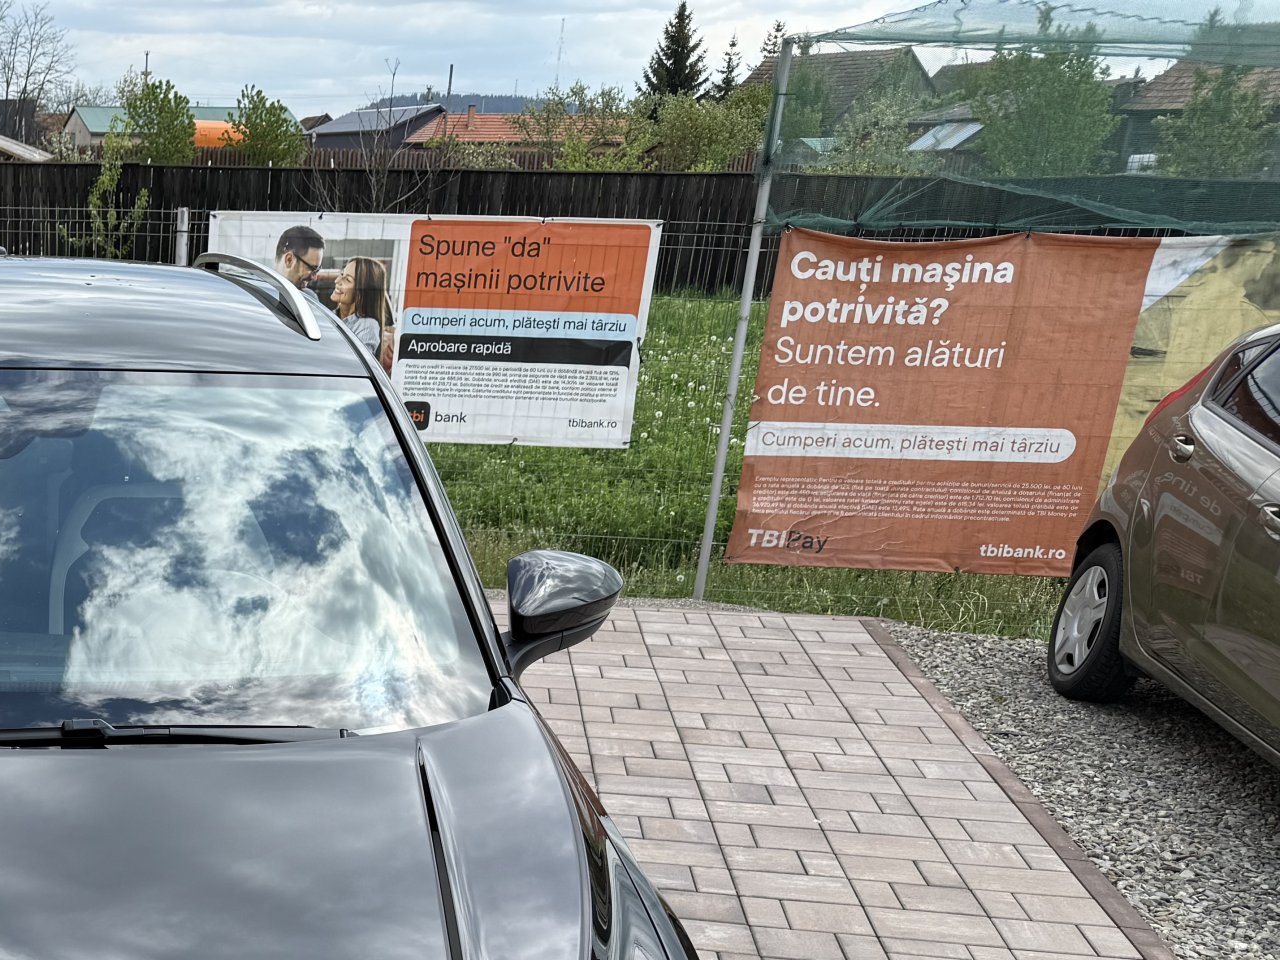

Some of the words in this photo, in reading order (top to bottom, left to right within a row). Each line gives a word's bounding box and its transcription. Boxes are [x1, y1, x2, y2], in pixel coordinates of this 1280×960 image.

[419, 234, 496, 260] Spune
[504, 236, 551, 258] "da"
[416, 269, 500, 294] mașinii
[506, 270, 606, 294] potrivite
[790, 251, 883, 293] Cauți
[411, 314, 466, 328] Cumperi
[470, 319, 509, 330] acum,
[563, 319, 588, 331] mai
[591, 319, 627, 333] târziu
[780, 295, 949, 328] potrivită?
[408, 339, 468, 354] Aprobare
[470, 341, 512, 356] rapidă
[774, 336, 895, 366] Suntem
[904, 340, 1007, 368] alături
[767, 378, 807, 405] de
[816, 379, 880, 407] tine.
[434, 411, 468, 424] bank
[568, 419, 618, 429] tbibank.ro
[762, 431, 837, 448] Cumperi
[842, 438, 895, 451] acum,
[972, 438, 1005, 453] mai
[1010, 438, 1060, 454] târziu
[979, 543, 1066, 560] tbibank.ro
